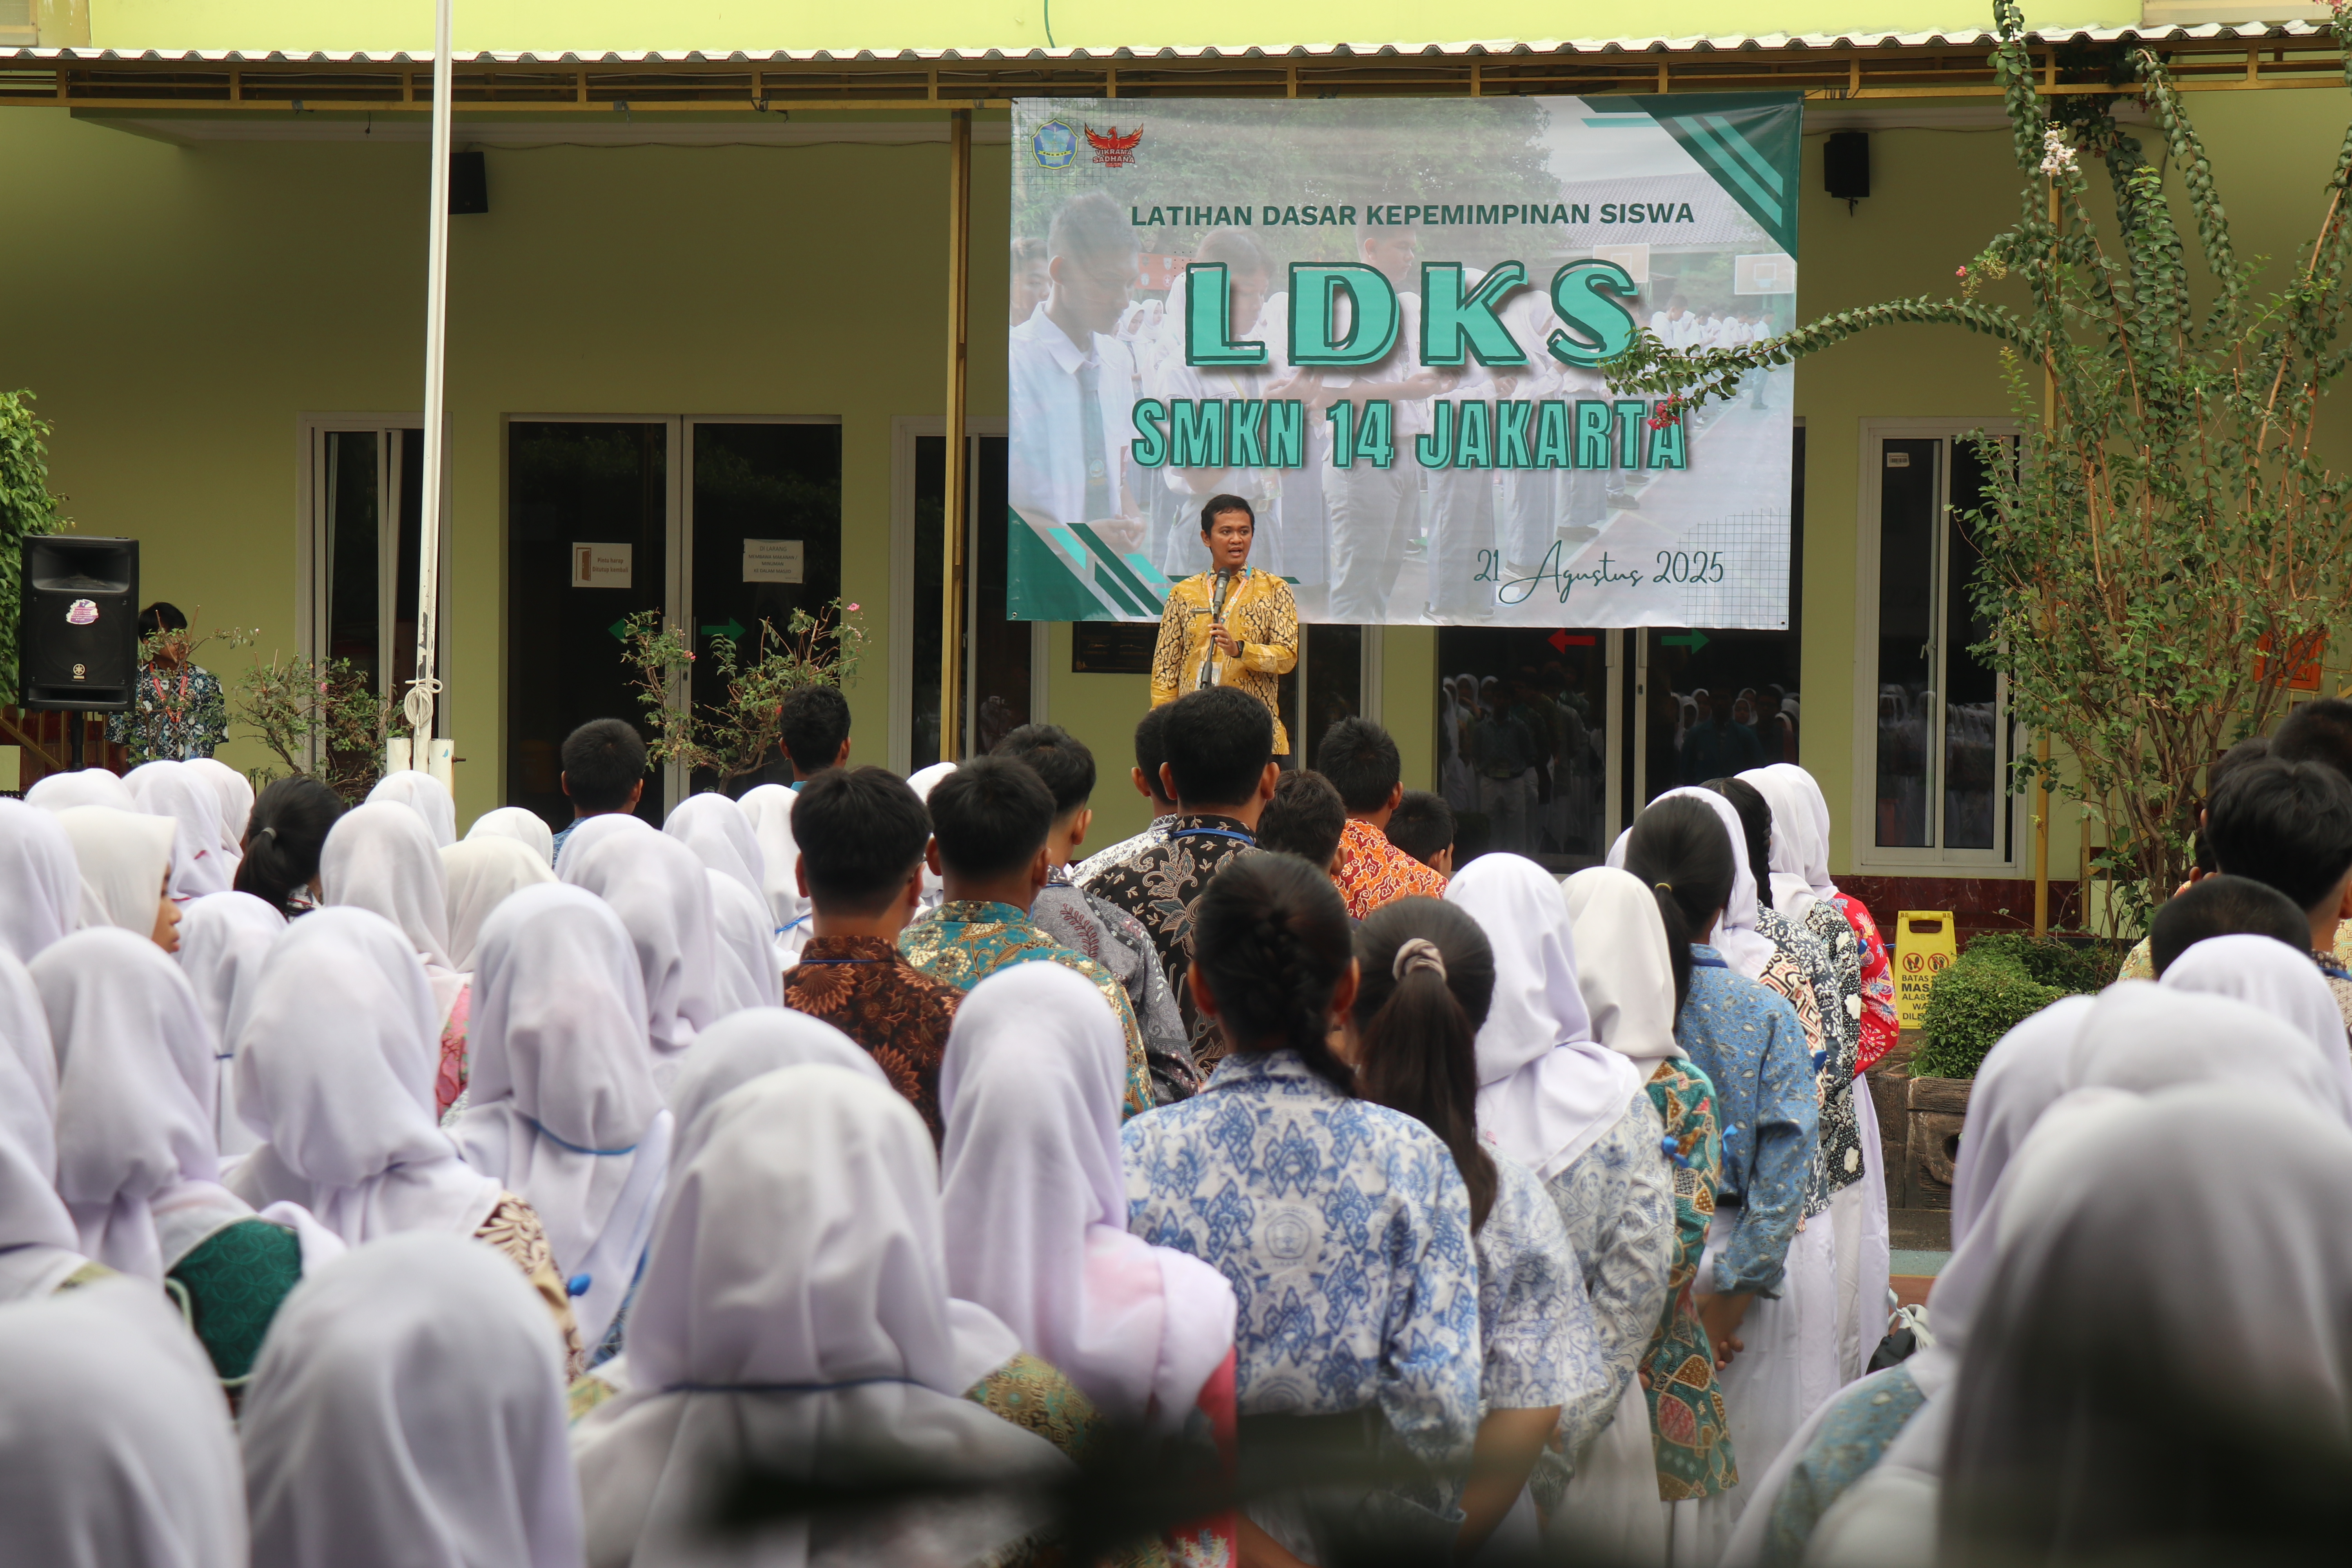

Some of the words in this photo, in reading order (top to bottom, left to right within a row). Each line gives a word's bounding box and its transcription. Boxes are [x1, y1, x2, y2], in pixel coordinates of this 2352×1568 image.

[1131, 206, 1252, 226] LATIHAN
[1262, 206, 1356, 225] DASAR
[1367, 204, 1589, 225] KEPEMIMPINAN
[1599, 203, 1694, 223] SISWA
[1185, 259, 1639, 369] LDKS
[1131, 398, 1304, 470] SMKN
[1327, 400, 1395, 470] 14
[1415, 400, 1687, 471] JAKARTA
[1474, 550, 1501, 582] 21
[1499, 540, 1644, 604] Agustus
[1653, 551, 1724, 584] 2025
